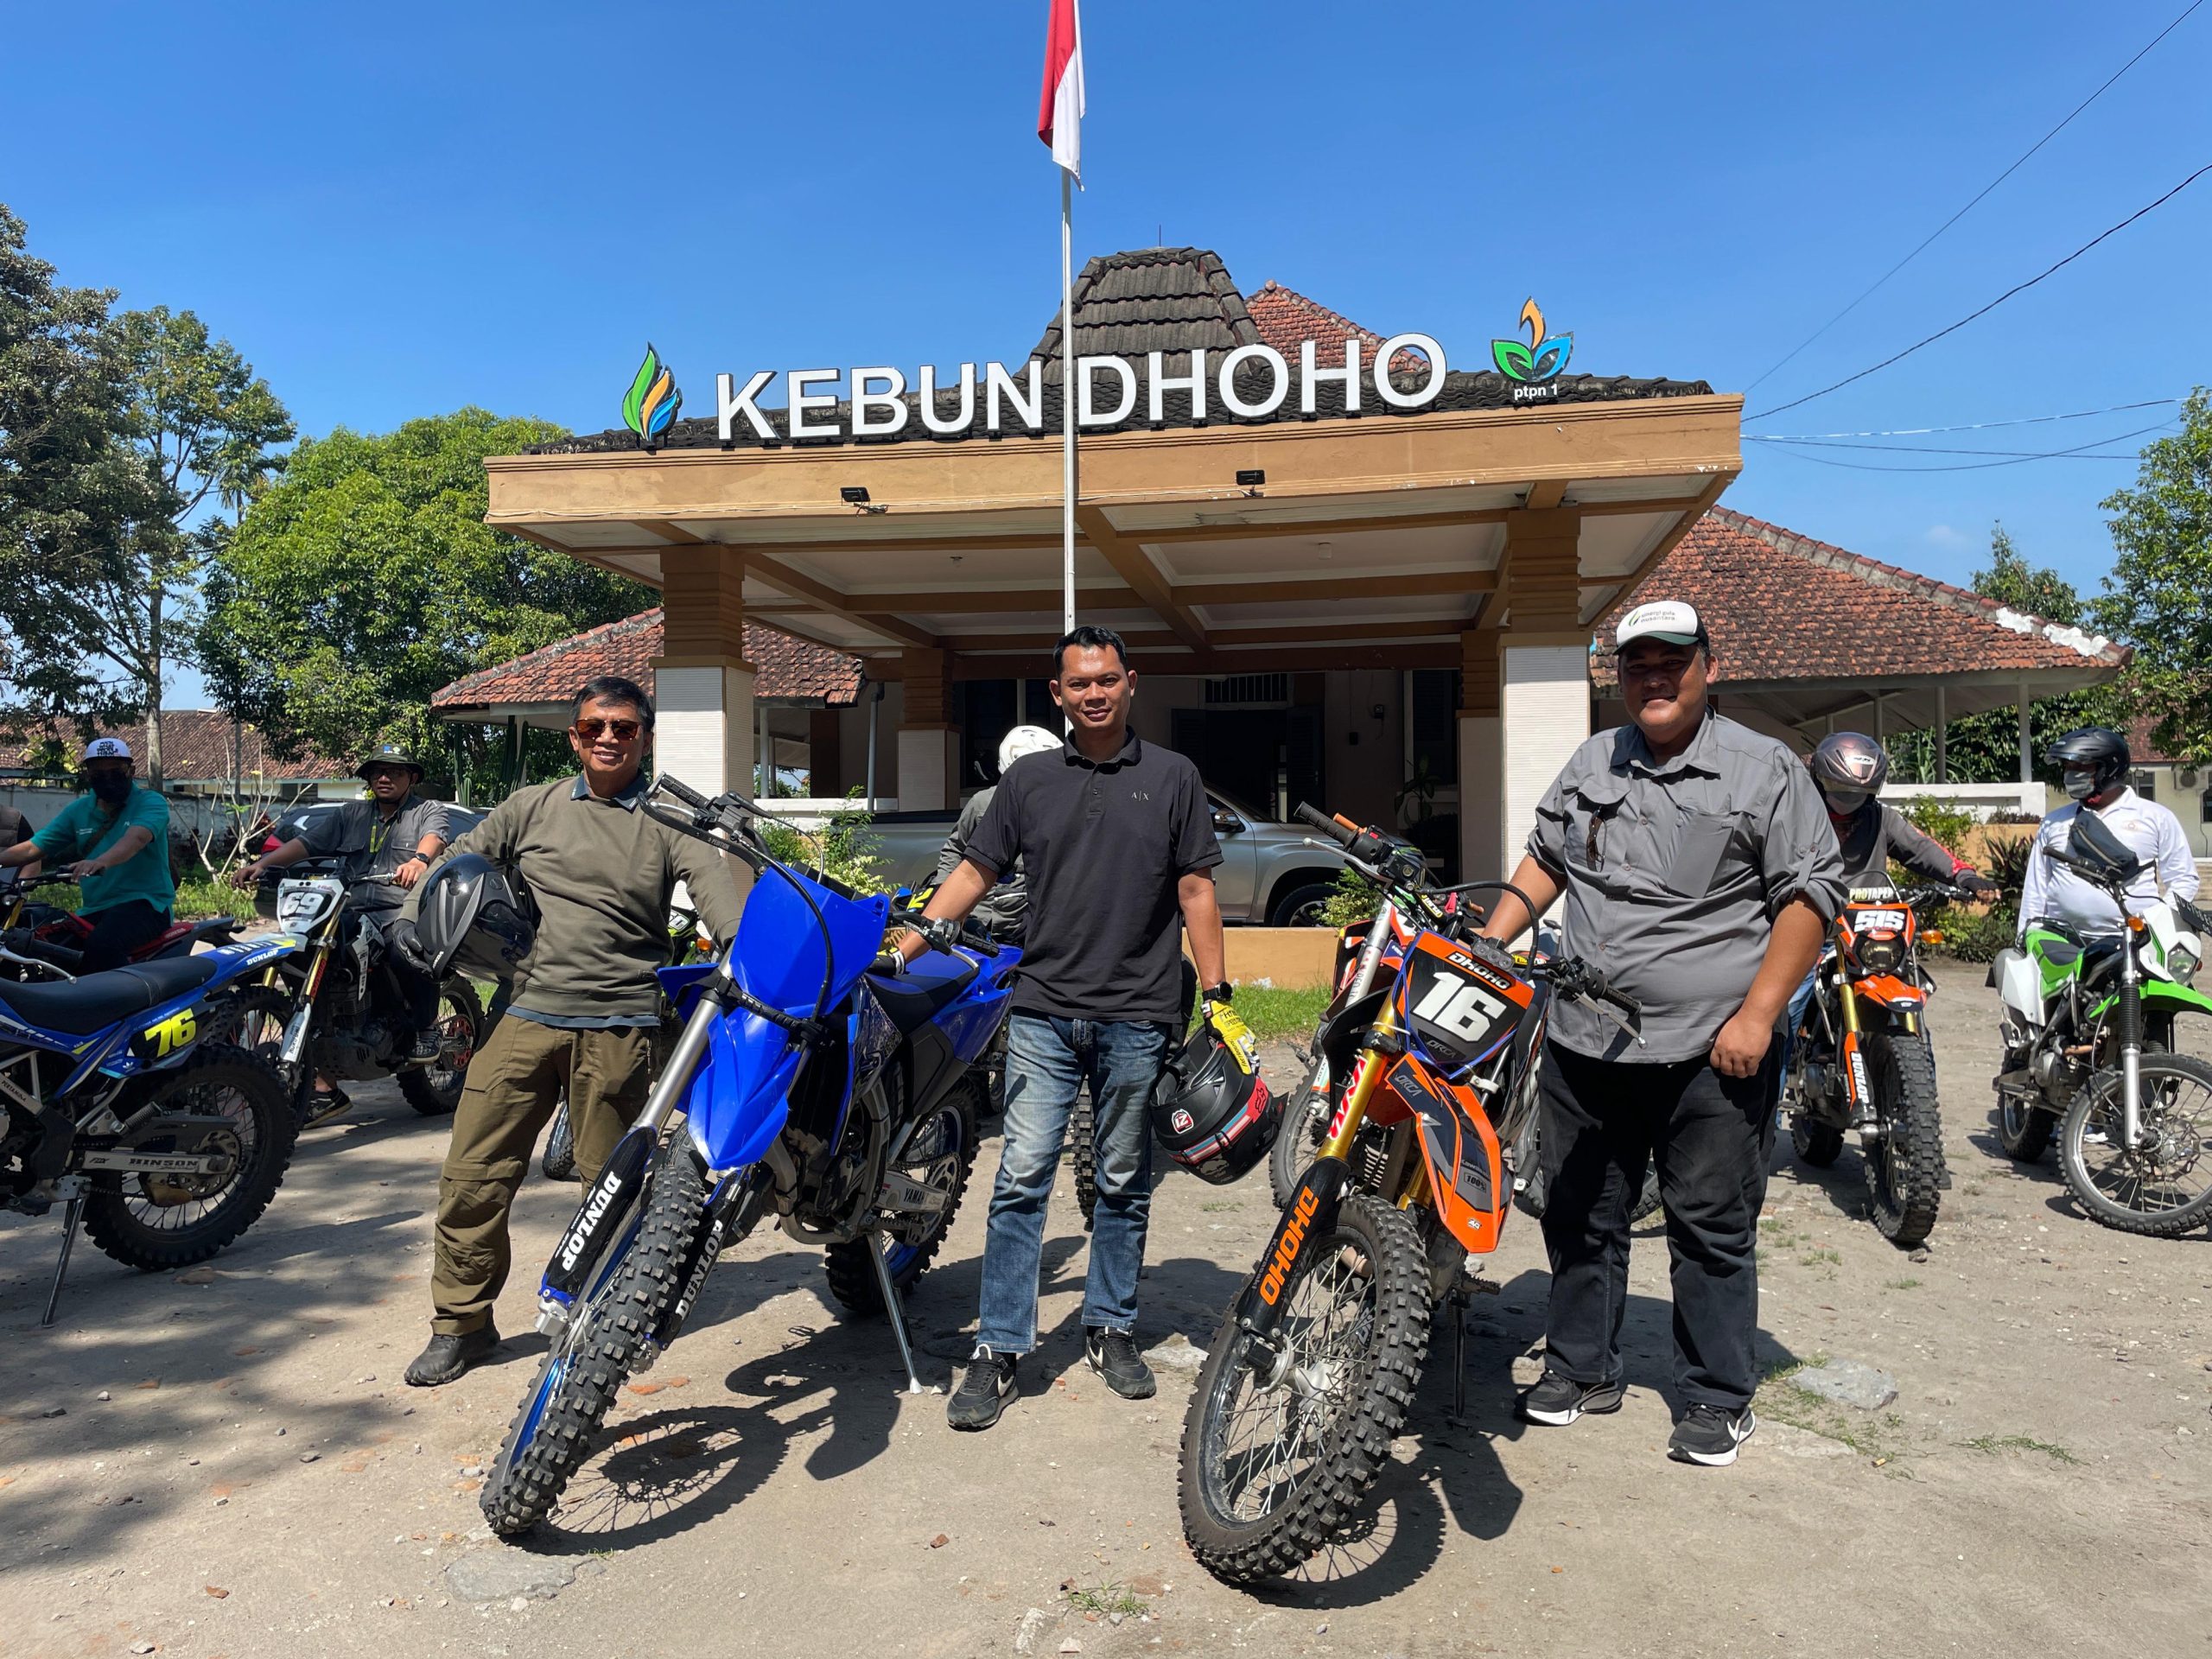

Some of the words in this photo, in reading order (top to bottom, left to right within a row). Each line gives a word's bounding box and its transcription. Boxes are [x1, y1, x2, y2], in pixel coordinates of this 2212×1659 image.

[716, 360, 1043, 440] KEBUN
[1078, 333, 1446, 426] DHOHO
[1515, 385, 1547, 400] ptpn
[1551, 383, 1558, 396] 1
[282, 892, 325, 916] 69
[1853, 910, 1906, 932] 515
[246, 949, 279, 966] DUNLOP
[1413, 972, 1507, 1042] 16
[144, 1007, 196, 1058] 76
[1427, 1039, 1457, 1058] ORCA
[1394, 1074, 1423, 1097] ORCA
[1851, 1052, 1869, 1103] DUNLOP
[130, 1158, 199, 1166] HINSON
[562, 1171, 622, 1271] DUNLOP
[675, 1219, 723, 1320] DUNLOP
